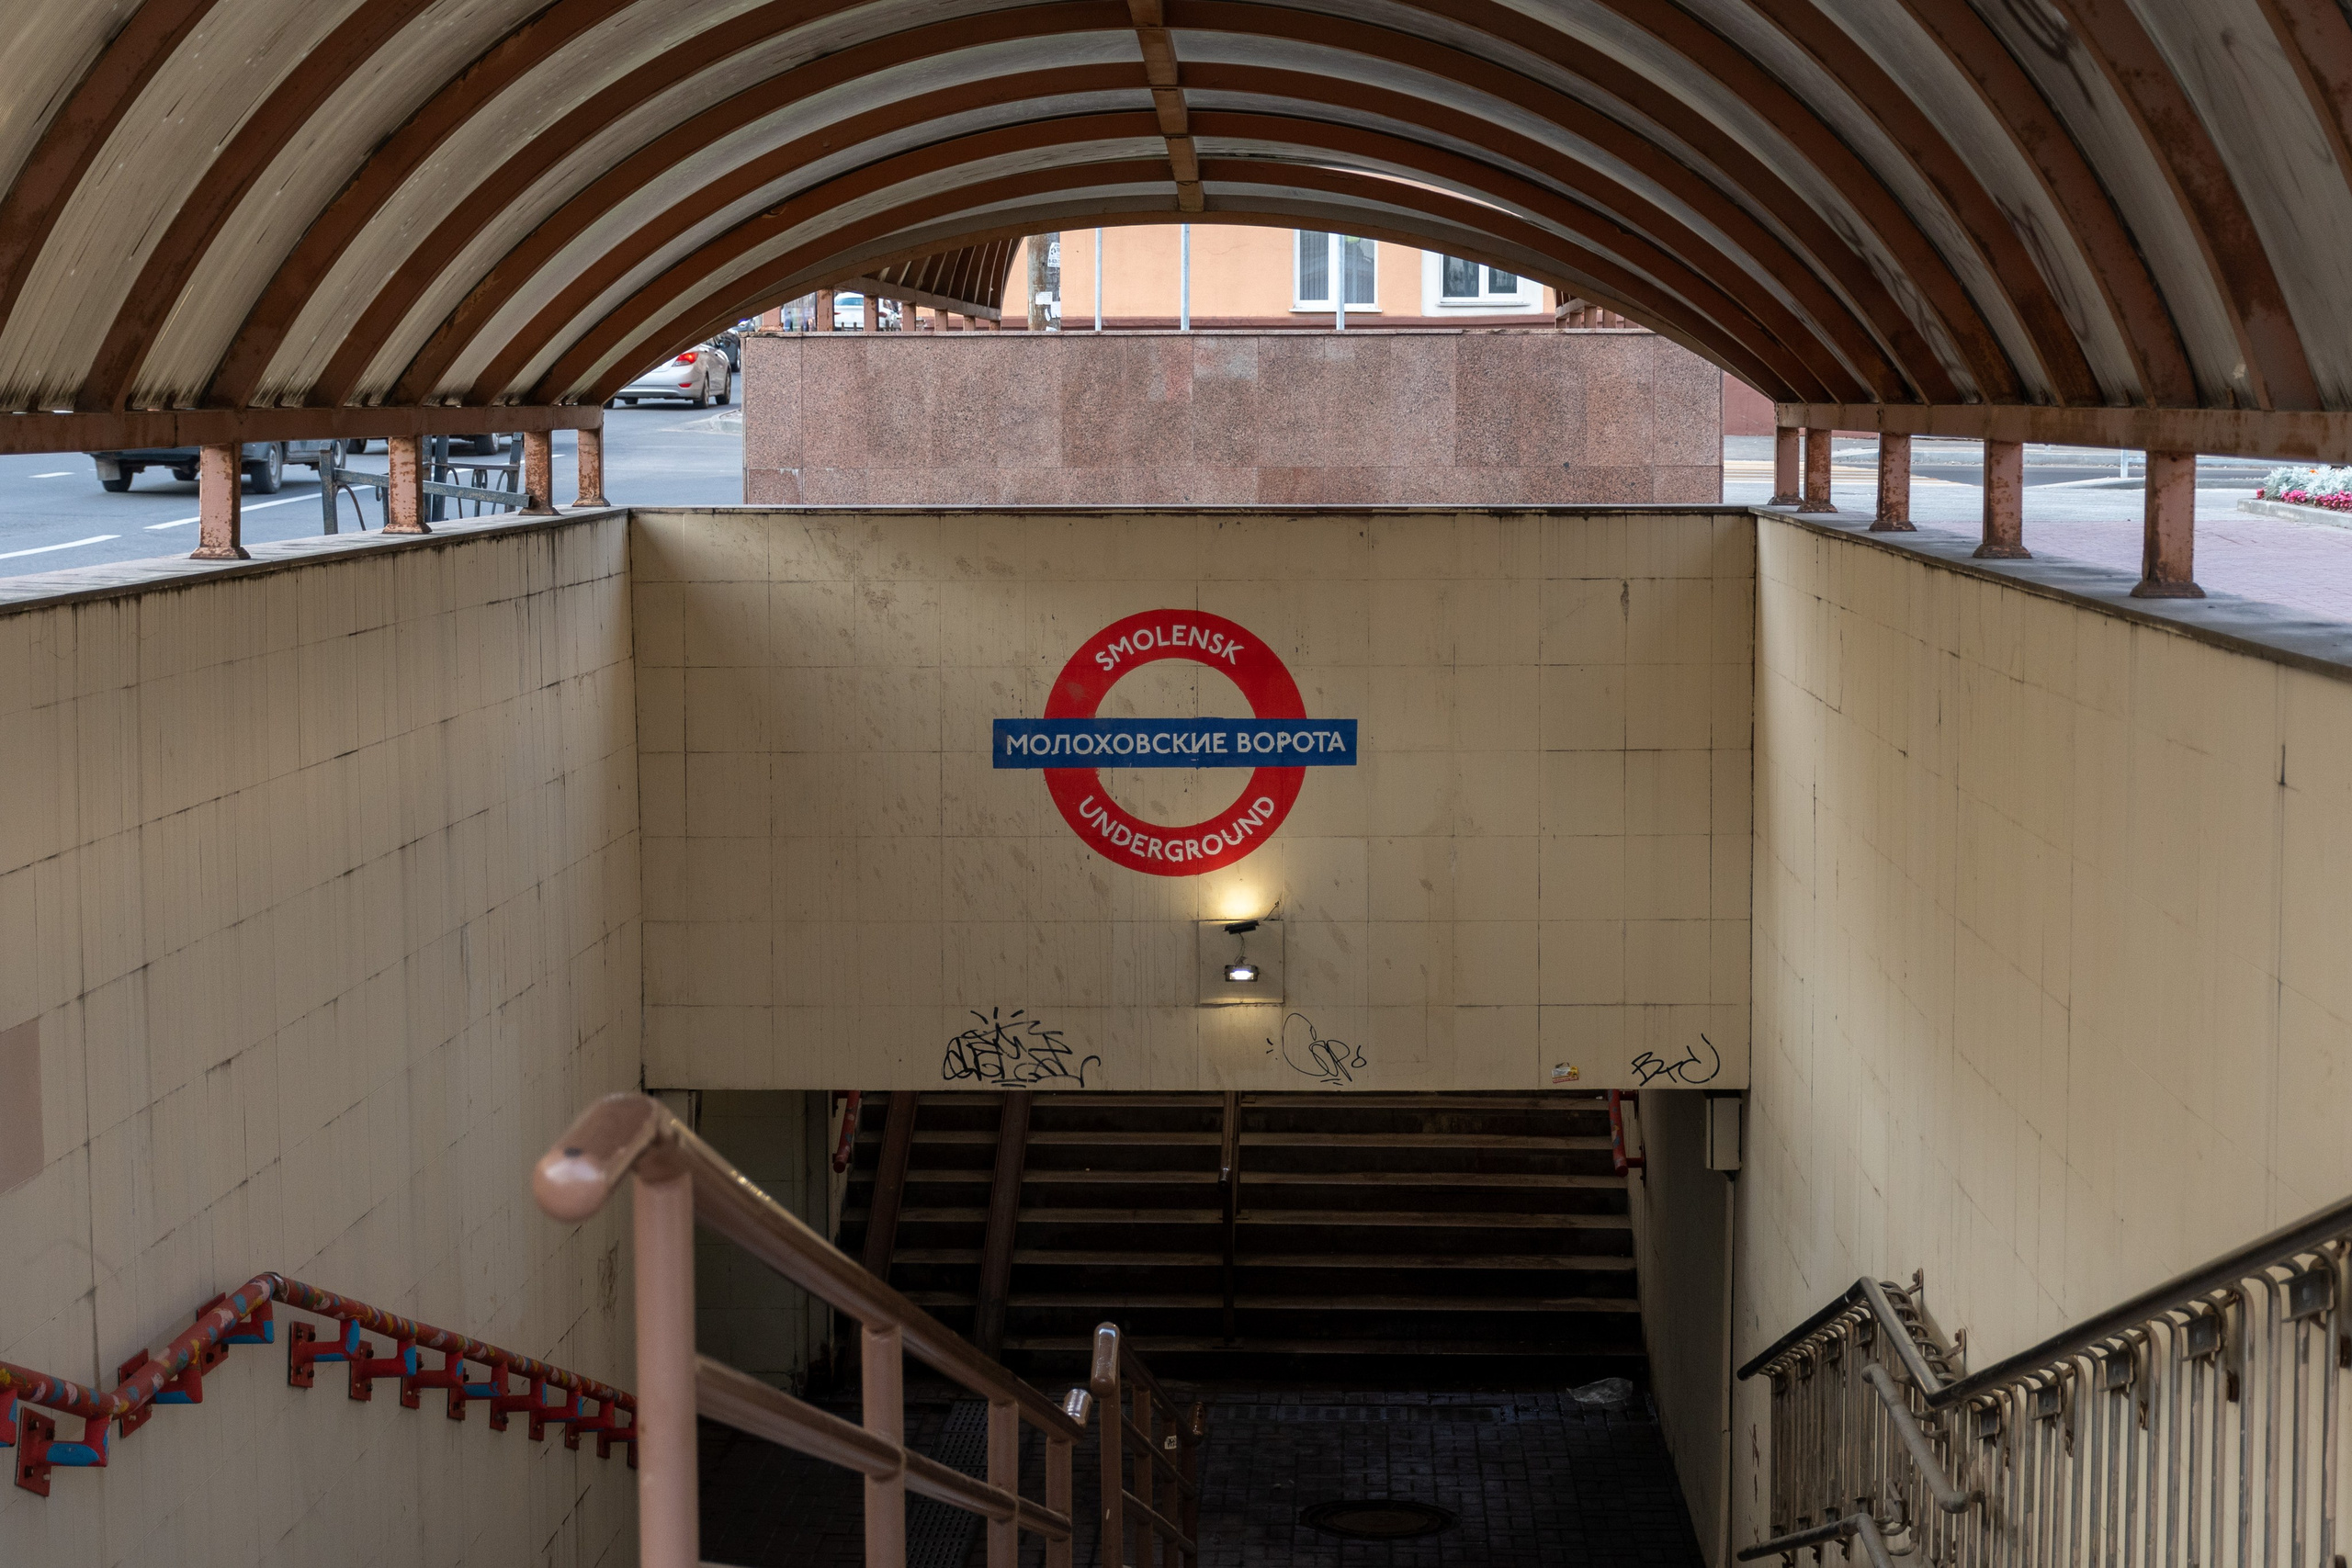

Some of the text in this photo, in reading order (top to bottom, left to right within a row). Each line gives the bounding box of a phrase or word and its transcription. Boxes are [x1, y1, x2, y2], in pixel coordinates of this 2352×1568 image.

[1095, 625, 1245, 671] SMOLENSK
[1007, 731, 1346, 755] МОЛОХОВСКИЕ ВОРОТА
[1079, 795, 1275, 863] UNDERGROUND
